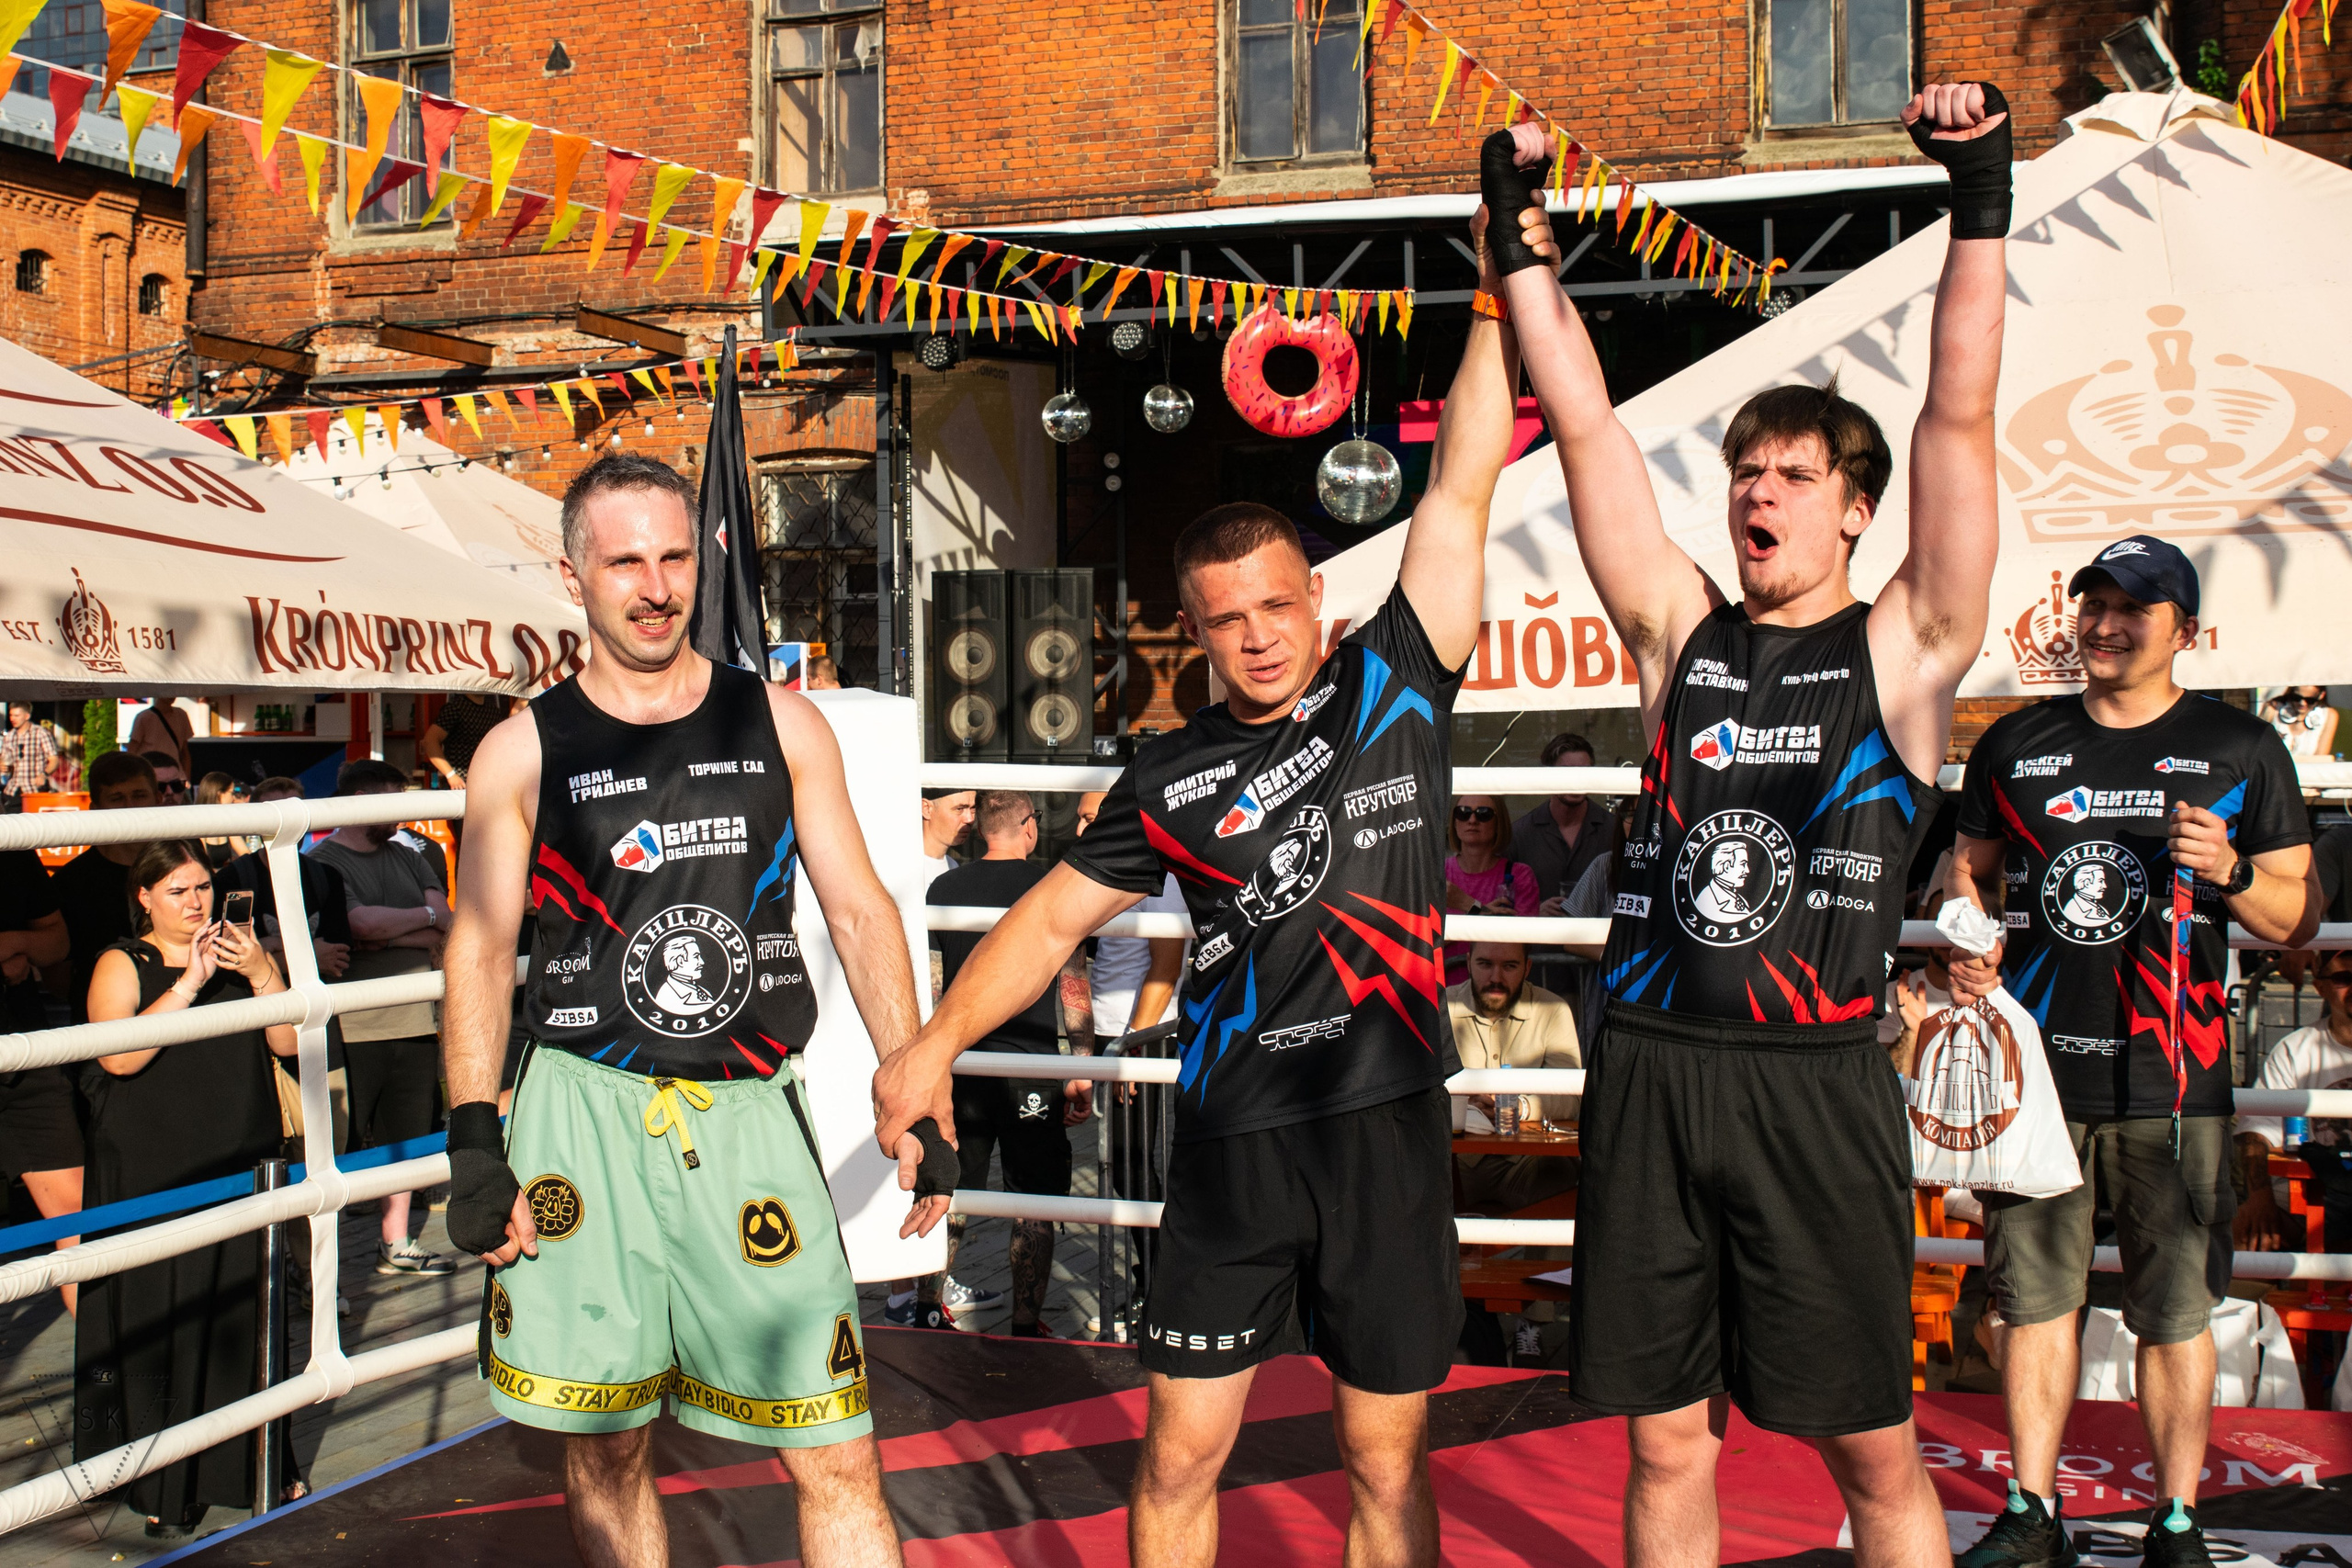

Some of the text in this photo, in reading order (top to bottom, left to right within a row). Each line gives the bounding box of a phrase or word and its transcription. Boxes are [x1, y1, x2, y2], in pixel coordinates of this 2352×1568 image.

[98, 446, 266, 513] 0.0
[2112, 540, 2147, 553] NIKE
[1, 619, 177, 652] EST. 1581
[1739, 725, 1822, 750] БИТВА
[687, 761, 764, 778] TOPWINE САД
[1253, 736, 1330, 798] БИТВА
[1736, 750, 1821, 764] ОБЩЕПИТОВ
[2175, 759, 2210, 771] БИТВА
[568, 769, 615, 790] ИВАН
[571, 776, 648, 804] ГРИДНЕВ
[1164, 760, 1237, 798] ДМИТРИЙ
[1262, 750, 1335, 812] ОБЩЕПИТОВ
[1165, 783, 1217, 812] ЖУКОВ
[1343, 781, 1418, 819] КРУТОЯР
[2093, 790, 2165, 807] БИТВА
[2090, 807, 2165, 818] ОБЩЕПИТОВ
[662, 816, 748, 847] БИТВА
[1379, 817, 1424, 840] LADOGA
[665, 840, 748, 862] ОБЩЕПИТОВ
[1678, 815, 1792, 886] КАНЦЛЕРЪ
[1631, 860, 1647, 870] GIN
[2044, 844, 2145, 900] КАНЦЛЕРЪ
[1828, 895, 1875, 913] ADOGA
[1686, 913, 1765, 940] 2010
[2057, 919, 2124, 940] 2010
[628, 909, 749, 984] КАНЦЛЕРЪ
[552, 1011, 595, 1024] SIBSA
[649, 1003, 730, 1031] 2010
[554, 1384, 621, 1408] STAY
[625, 1377, 669, 1407] TRUE
[705, 1389, 753, 1421] BIDLO
[770, 1397, 831, 1425] STAY
